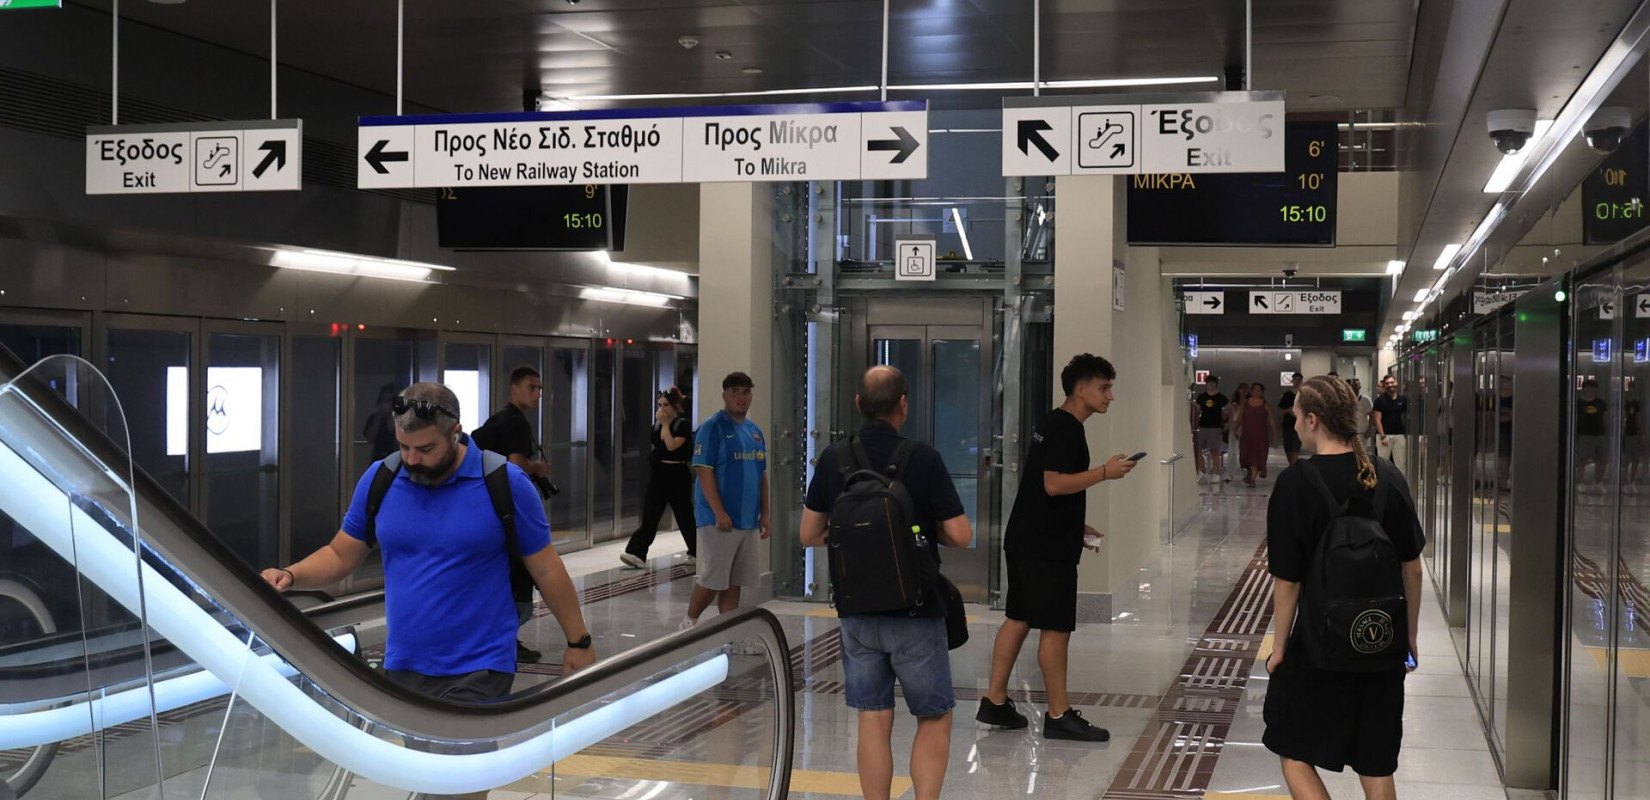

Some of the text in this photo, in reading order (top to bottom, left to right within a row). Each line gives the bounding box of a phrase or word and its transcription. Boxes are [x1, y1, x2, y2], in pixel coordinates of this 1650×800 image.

[434, 124, 661, 157] Προς Νέο Σιδ. Σταθμό
[705, 120, 837, 151] Προς Μίκρα
[95, 138, 183, 166] Έξοδος
[1308, 140, 1325, 157] 6'
[734, 157, 807, 175] To Mikra
[1187, 148, 1232, 167] Exit
[123, 171, 156, 188] Exit
[454, 161, 640, 183] To New Railway Station
[1298, 173, 1324, 190] 10'
[563, 213, 602, 228] 15:10
[1280, 205, 1327, 222] 15:10
[1369, 627, 1378, 640] V
